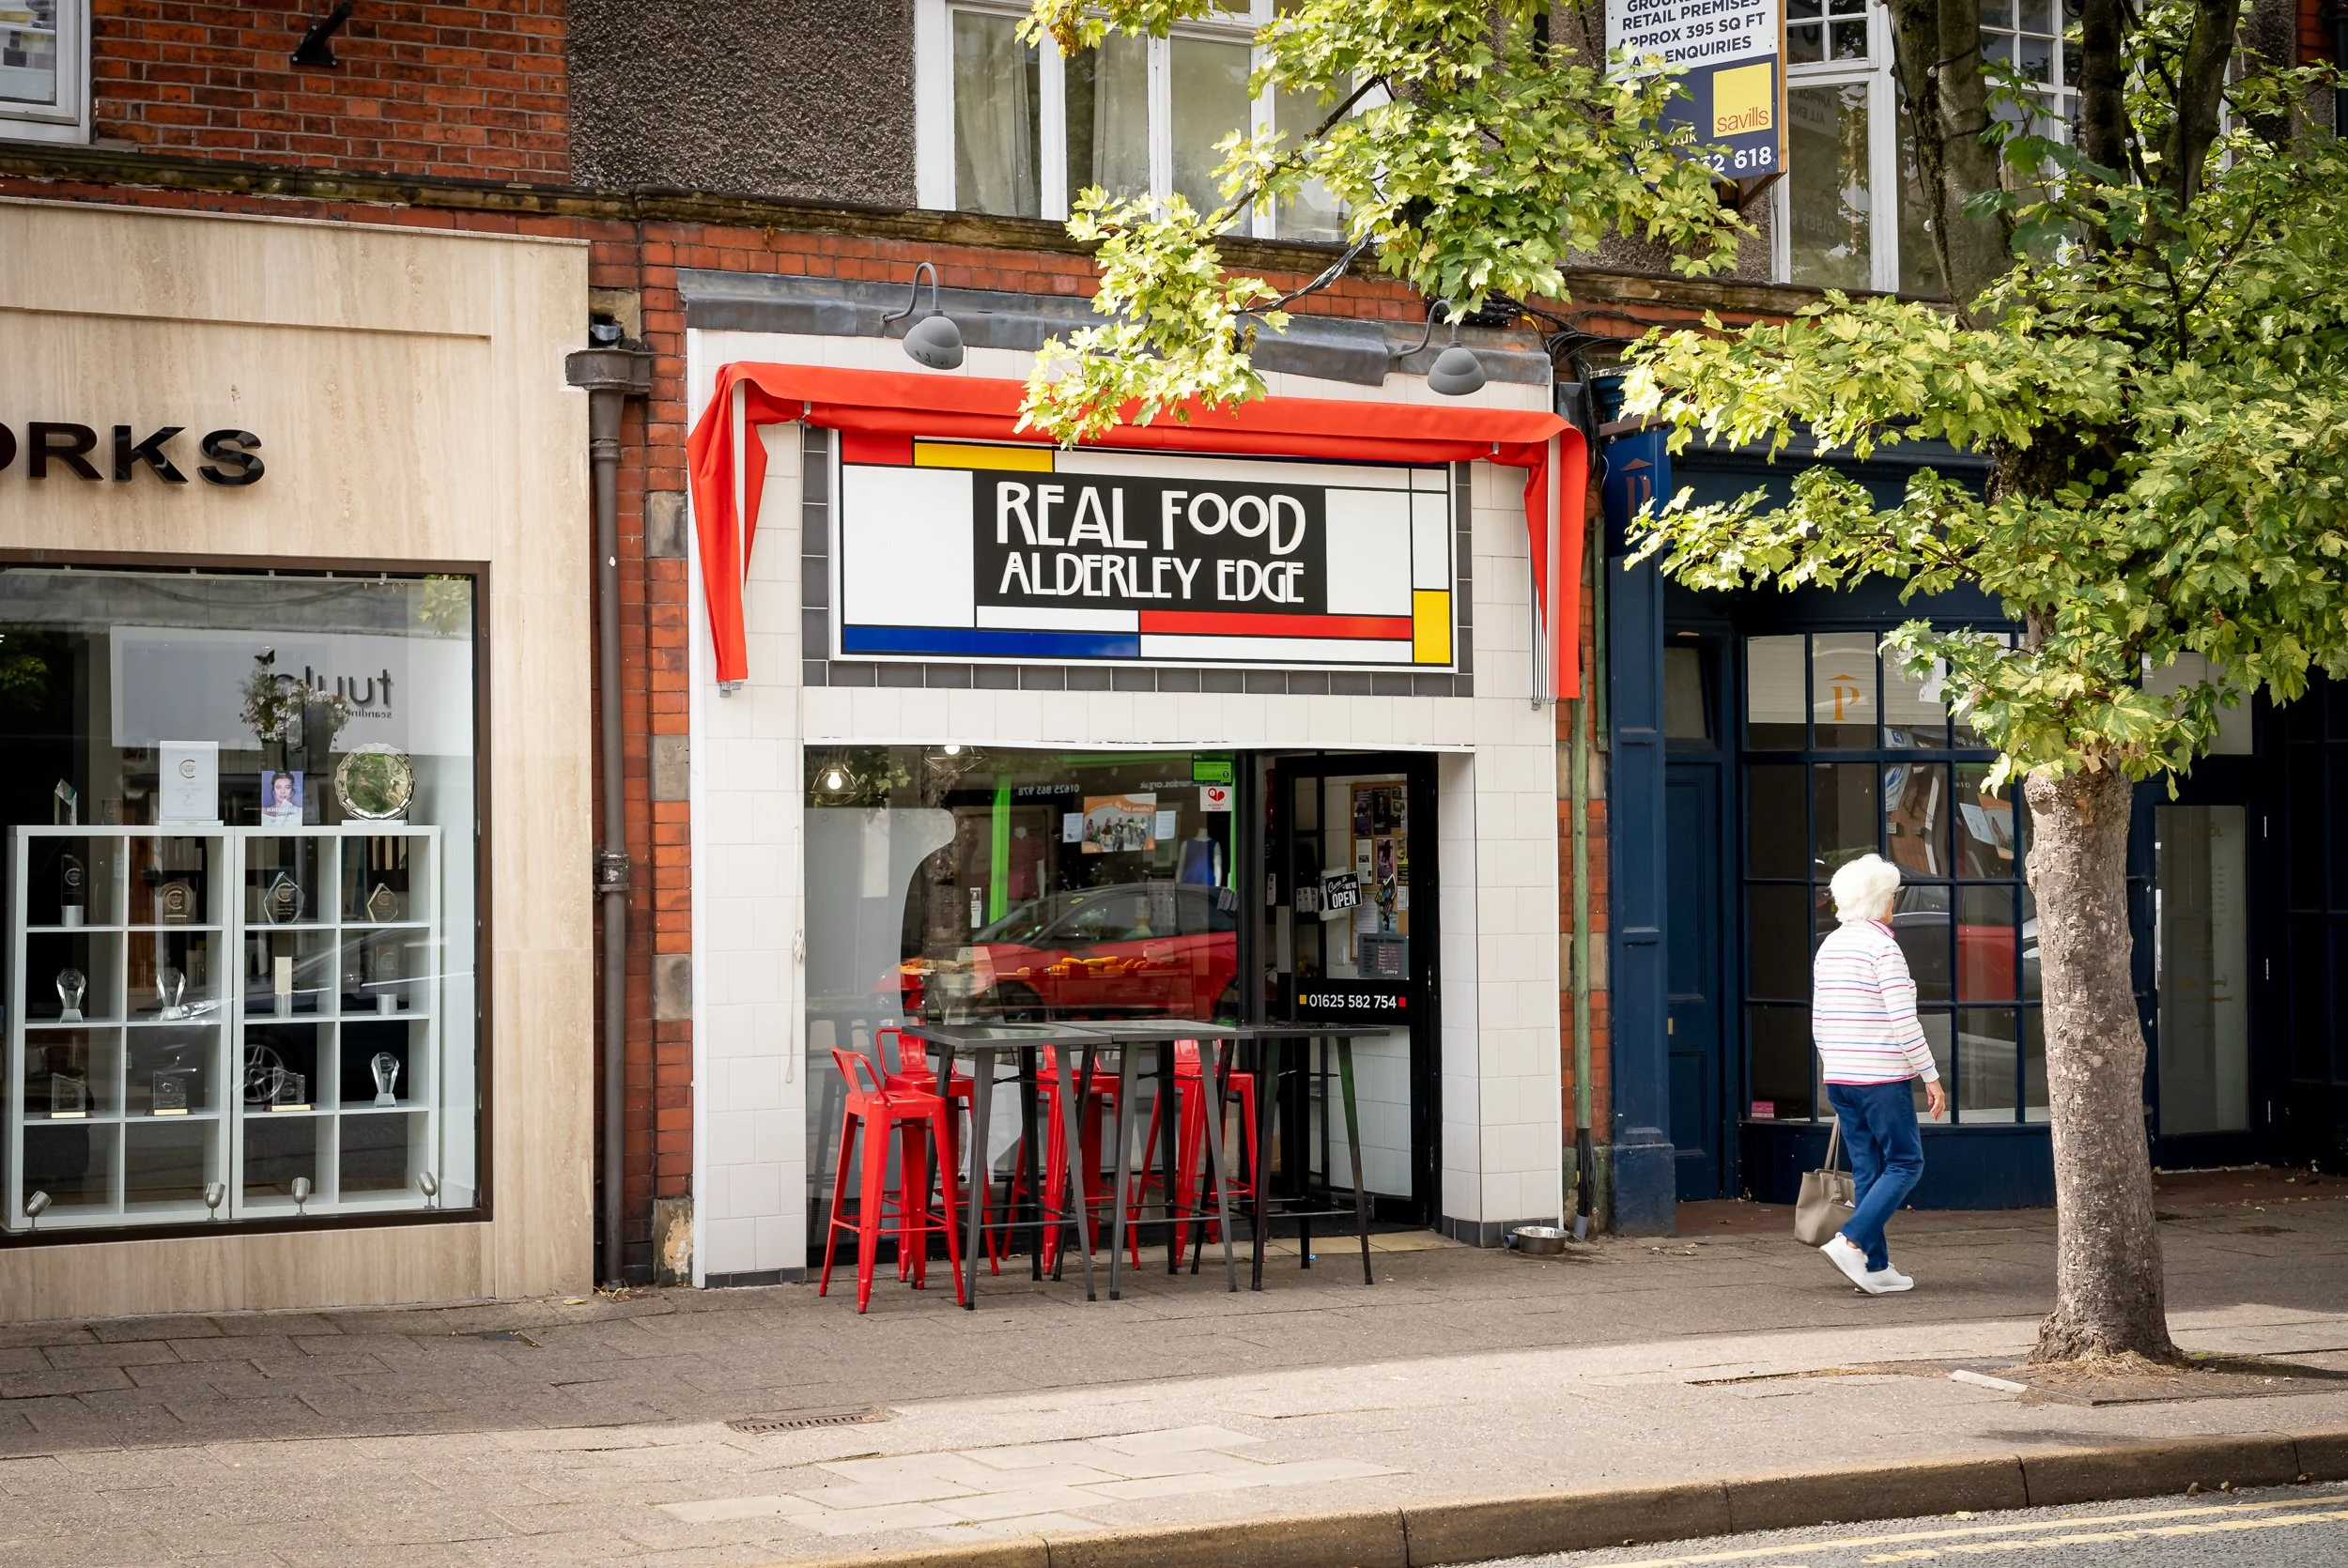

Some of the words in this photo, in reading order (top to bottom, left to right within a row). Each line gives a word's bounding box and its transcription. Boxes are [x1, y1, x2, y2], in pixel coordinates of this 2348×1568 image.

[1627, 0, 1691, 12] GRO
[1622, 9, 1676, 30] RETAIL
[1686, 22, 1714, 38] 395
[1719, 17, 1741, 32] SQ
[1746, 12, 1766, 28] FT
[1664, 36, 1752, 63] ENQUIRIES
[1717, 106, 1769, 132] savills
[1734, 146, 1772, 169] 618
[0, 422, 266, 487] RKS
[996, 481, 1148, 550] REAL
[1162, 490, 1306, 556] FOOD
[998, 551, 1202, 600] ALDERLEY
[1217, 559, 1305, 604] EDGE
[1332, 890, 1356, 908] OPEN
[1309, 994, 1345, 1007] 01625
[1348, 995, 1370, 1008] 582
[1373, 995, 1397, 1008] 754
